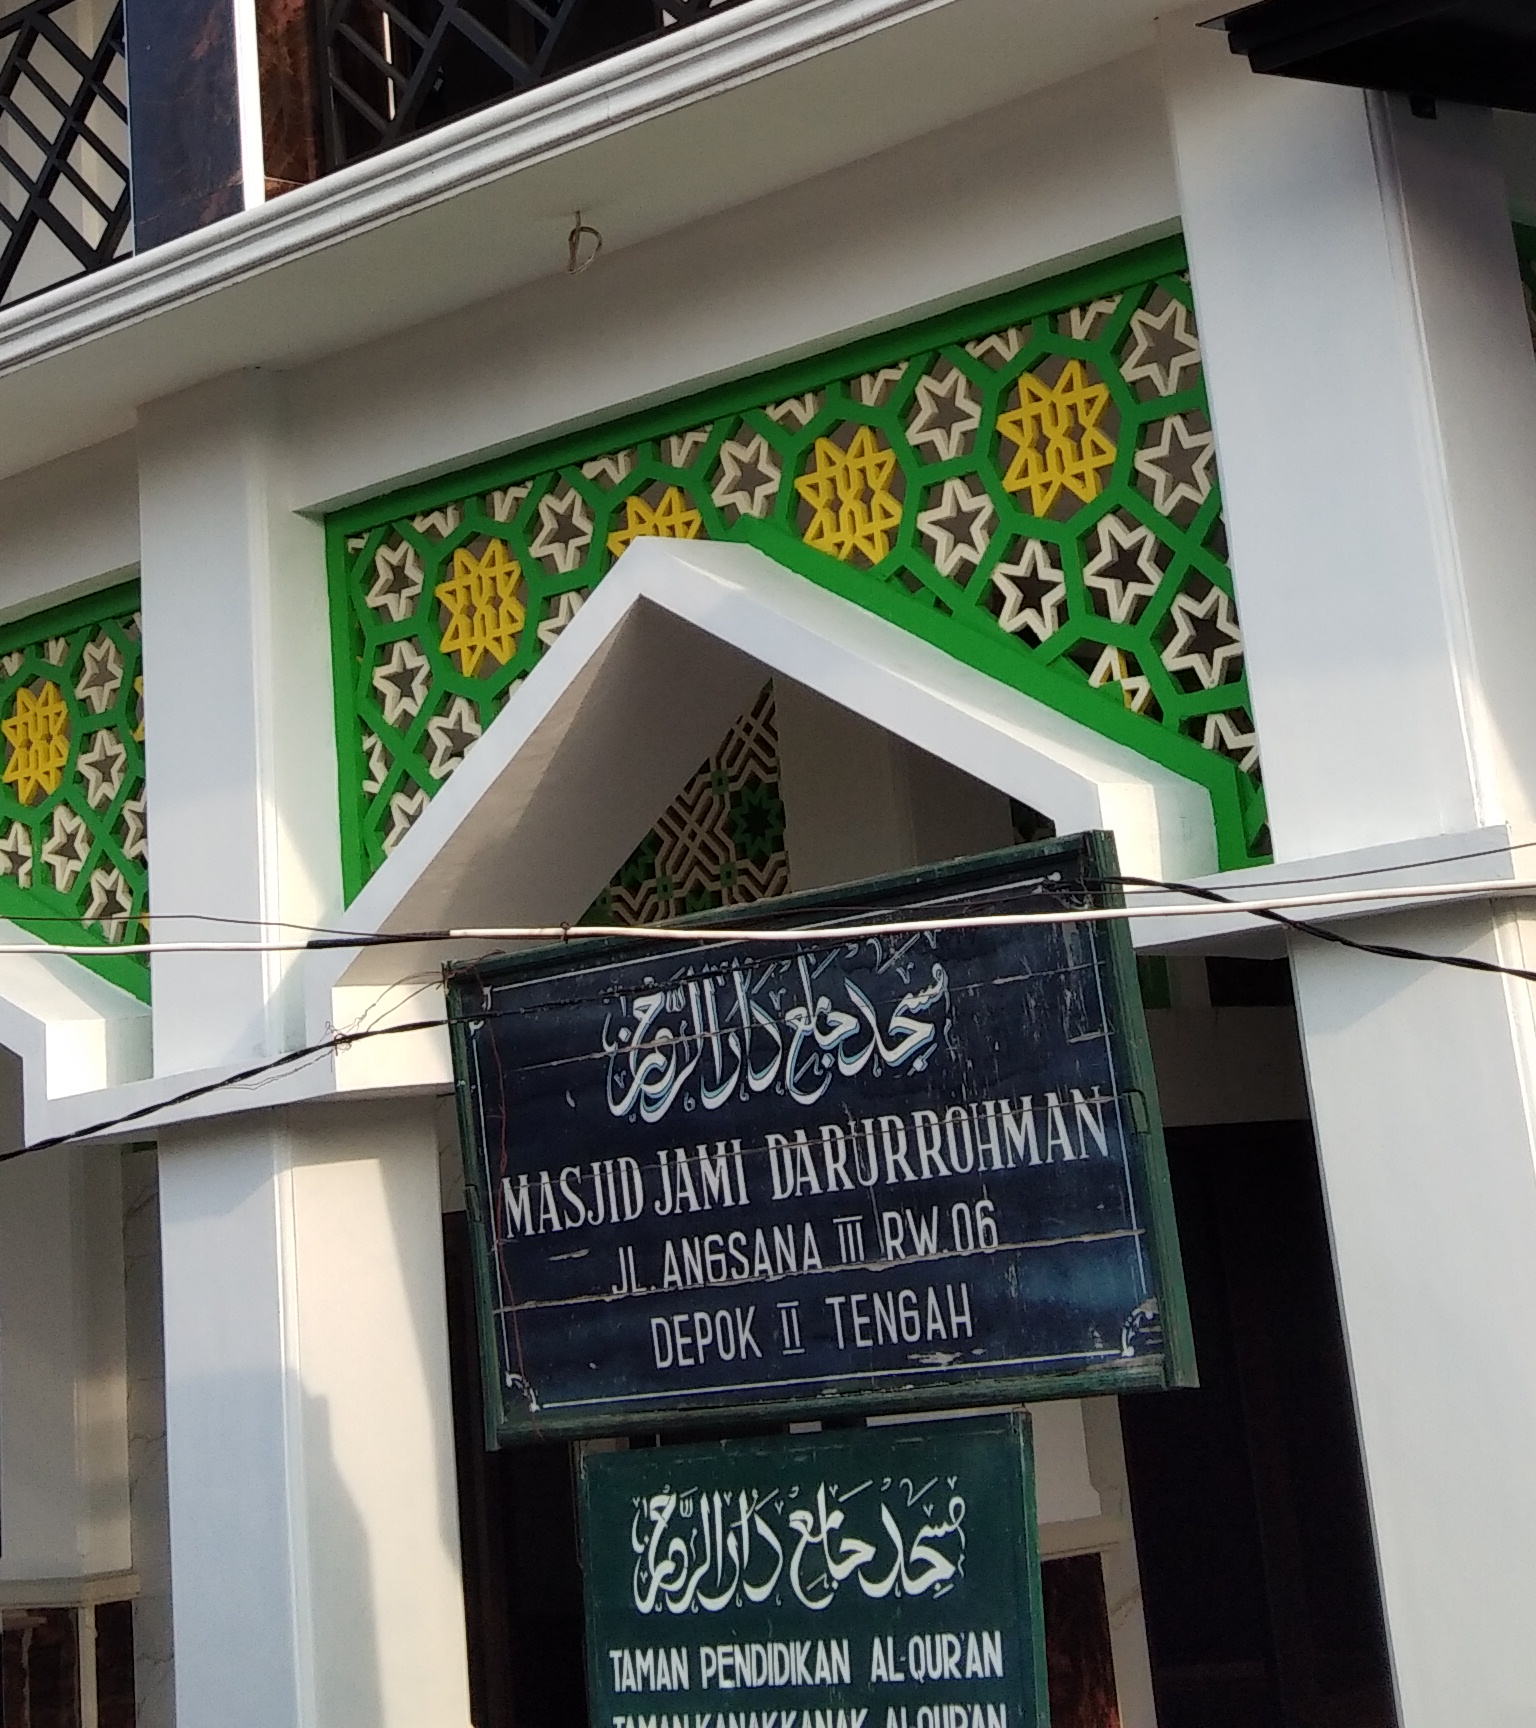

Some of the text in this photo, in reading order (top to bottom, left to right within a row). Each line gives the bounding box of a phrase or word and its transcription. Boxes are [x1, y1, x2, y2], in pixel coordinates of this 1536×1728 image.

[501, 1085, 1111, 1239] MASJID JAMI DARURROHMAN
[612, 1198, 1000, 1295] JL. ANGSANA III RW.06
[650, 1282, 974, 1369] DEPOK II TENGAH
[608, 1630, 1005, 1693] TAMAN PENDIDIKAN AL-QUR'AN
